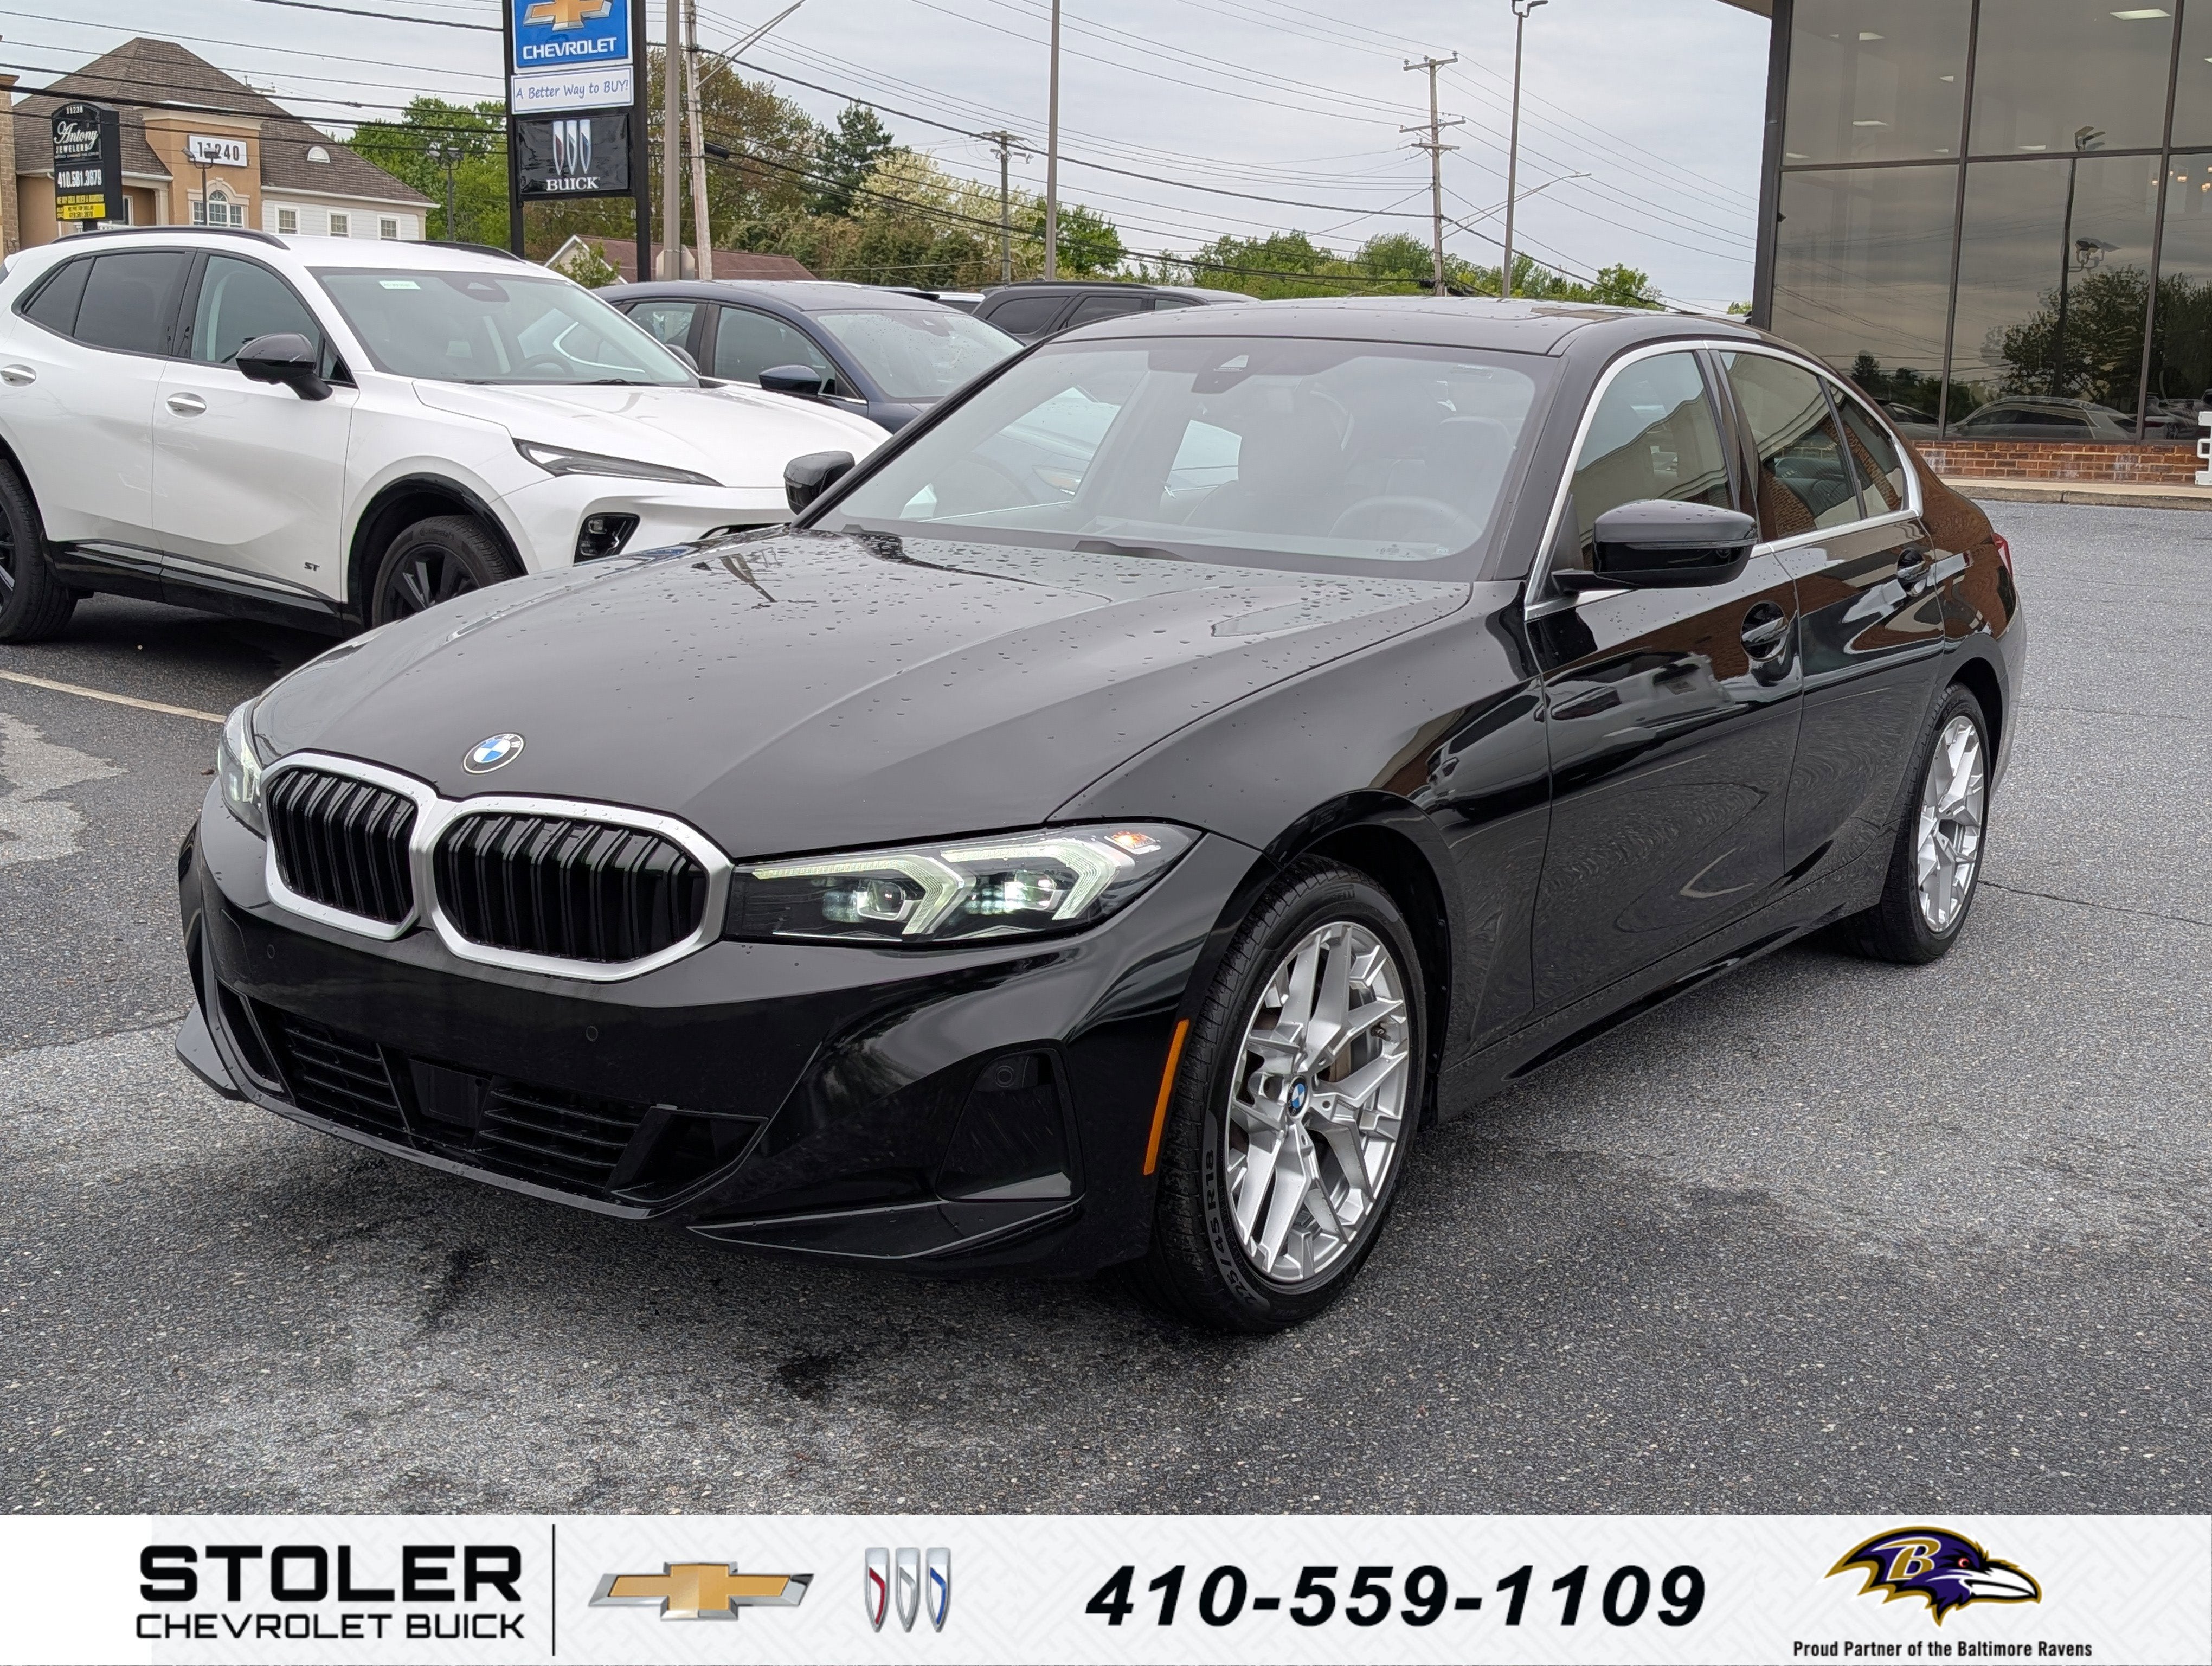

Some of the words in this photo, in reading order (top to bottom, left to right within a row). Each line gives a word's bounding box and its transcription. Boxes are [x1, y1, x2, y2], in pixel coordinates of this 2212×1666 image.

[523, 37, 617, 60] CHEVROLET
[516, 88, 524, 99] A
[528, 87, 560, 99] Better
[563, 84, 585, 99] Way
[589, 82, 599, 94] to
[603, 79, 629, 93] BUY!
[54, 121, 98, 150] Antony
[56, 144, 88, 154] JEWELERS
[546, 177, 599, 191] BUICK
[304, 562, 320, 572] ST
[1205, 1149, 1217, 1211] R18
[1210, 1216, 1257, 1305] 225/45
